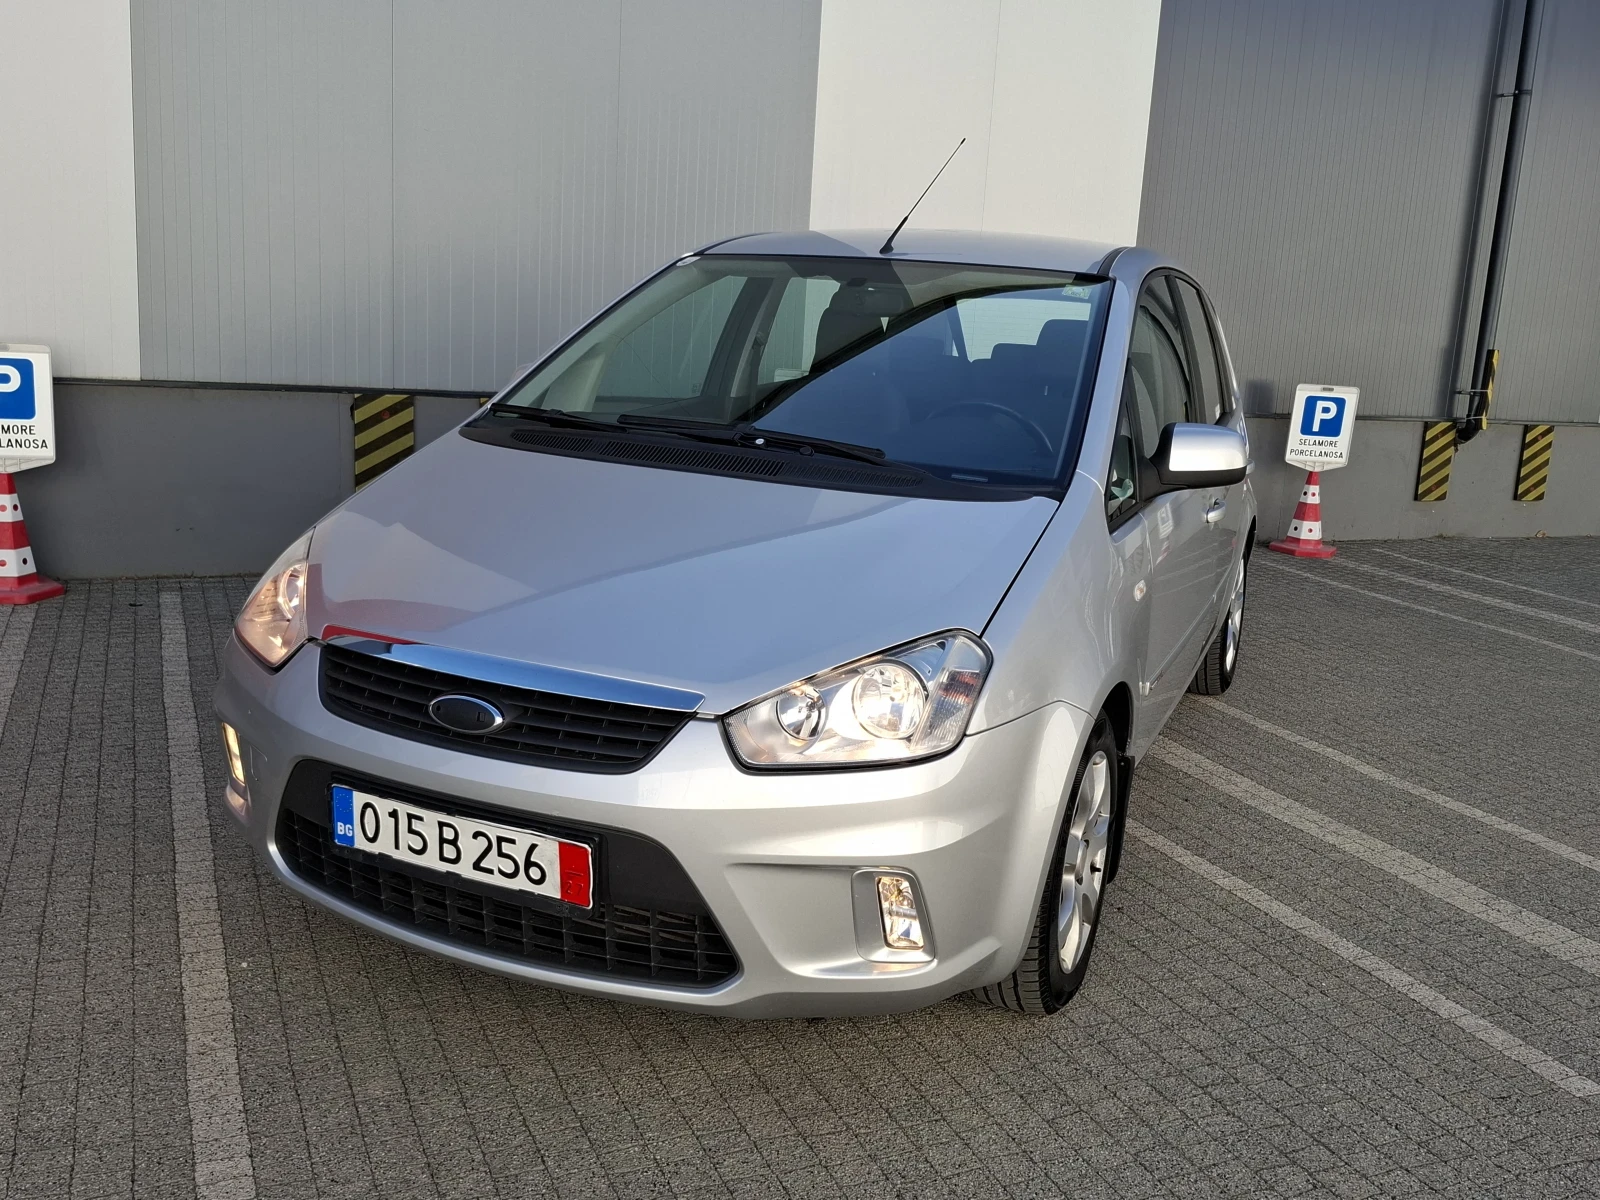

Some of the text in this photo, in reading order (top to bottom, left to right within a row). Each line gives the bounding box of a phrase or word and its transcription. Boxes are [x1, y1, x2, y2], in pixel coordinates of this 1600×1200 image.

[1312, 400, 1338, 432] P
[1298, 438, 1339, 448] SELAMORE
[1289, 448, 1344, 459] PORCELANOSA
[337, 821, 353, 837] BG
